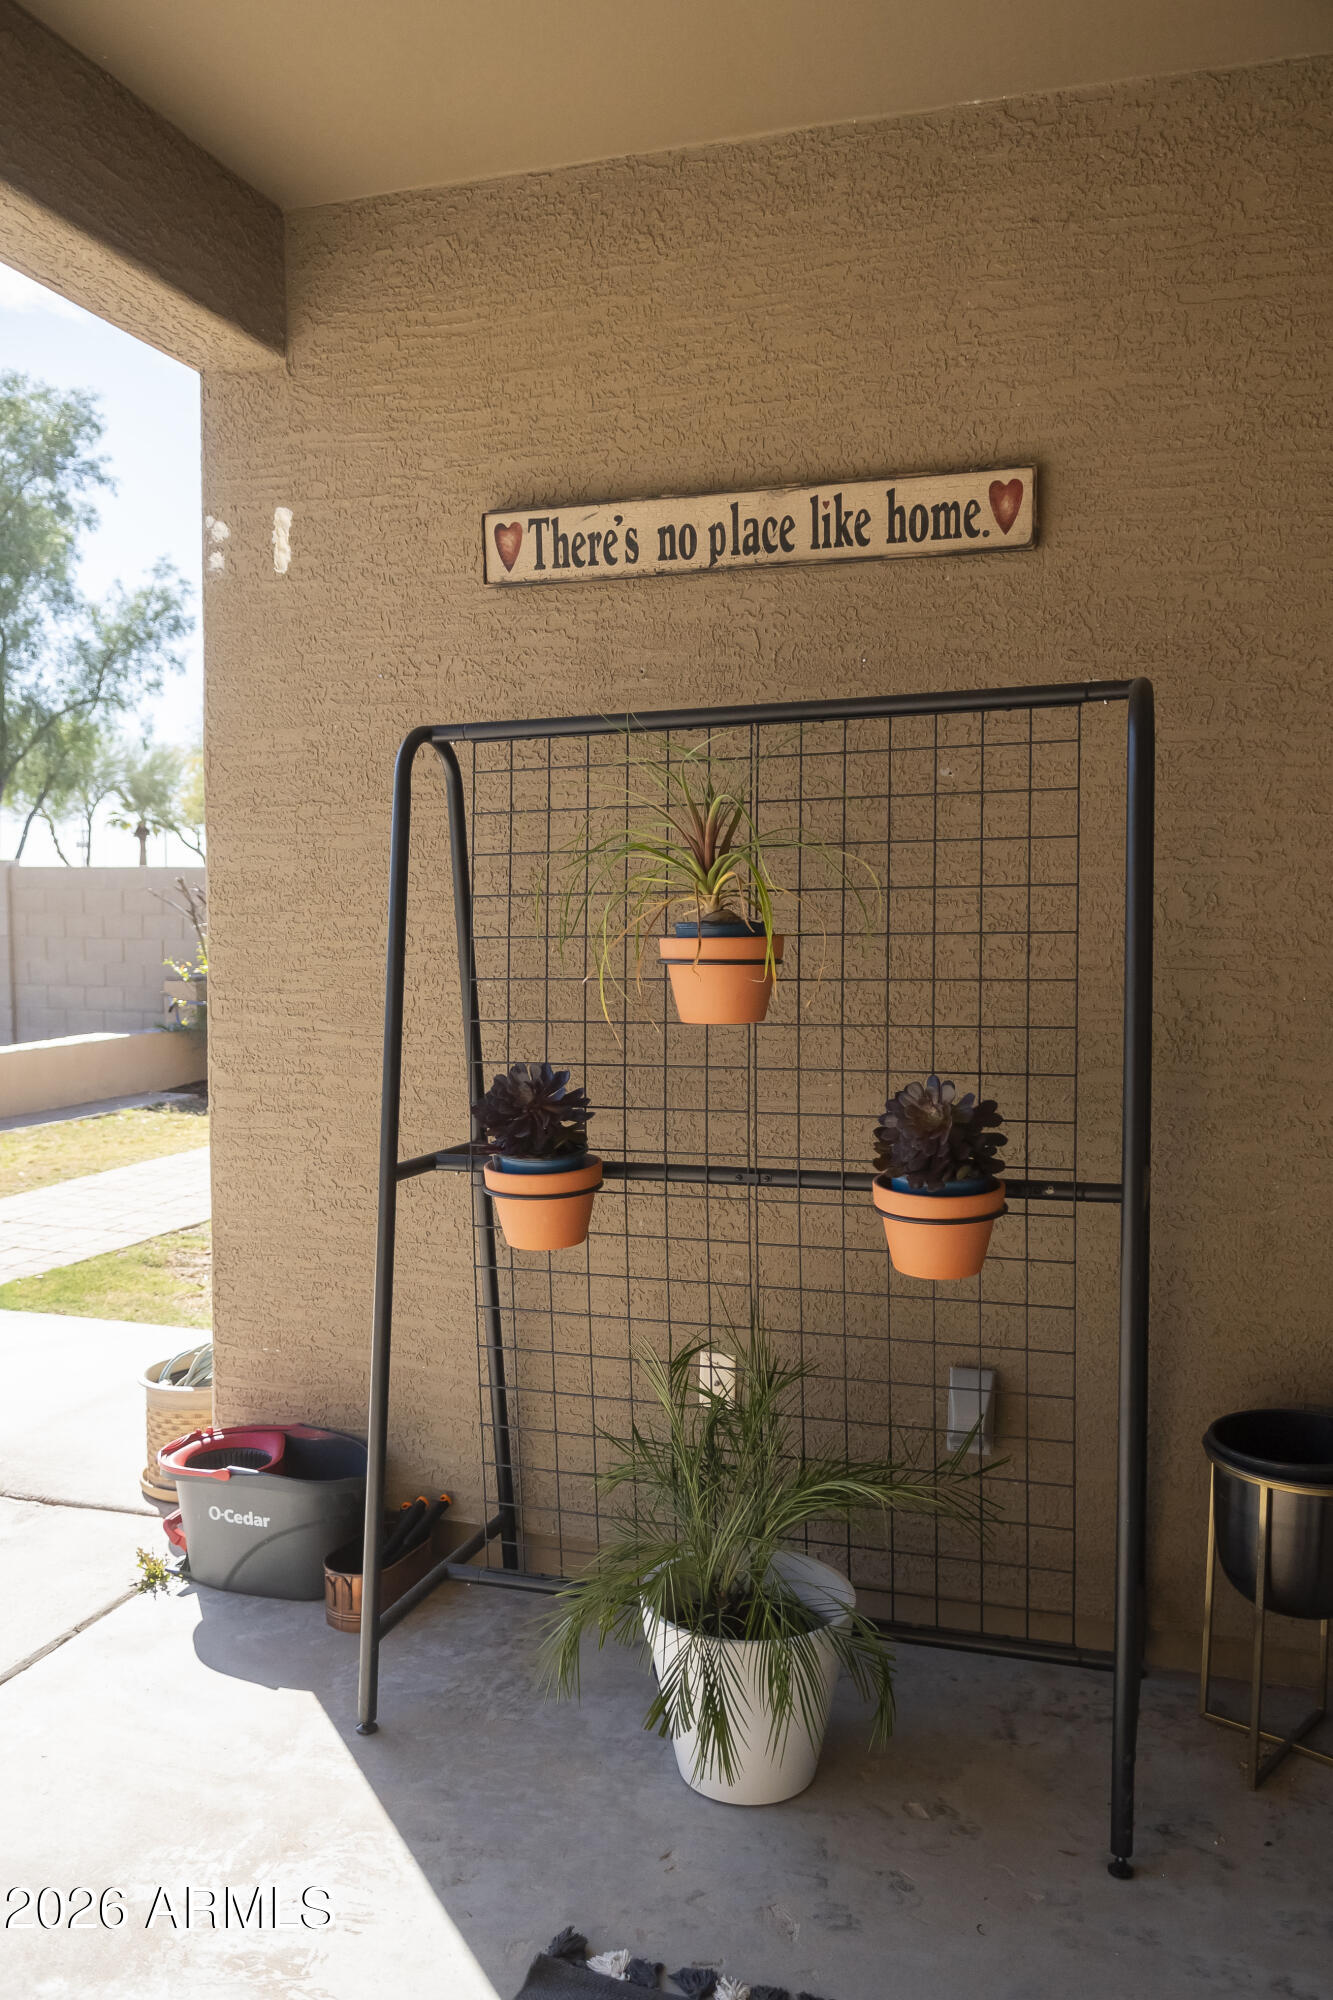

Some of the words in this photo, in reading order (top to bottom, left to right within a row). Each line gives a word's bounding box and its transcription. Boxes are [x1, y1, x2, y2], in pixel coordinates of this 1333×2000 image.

[527, 514, 640, 570] There's
[657, 522, 698, 561] no
[707, 501, 796, 568] place
[810, 492, 872, 550] like
[886, 487, 990, 544] home.
[208, 1505, 271, 1528] O-Cedar
